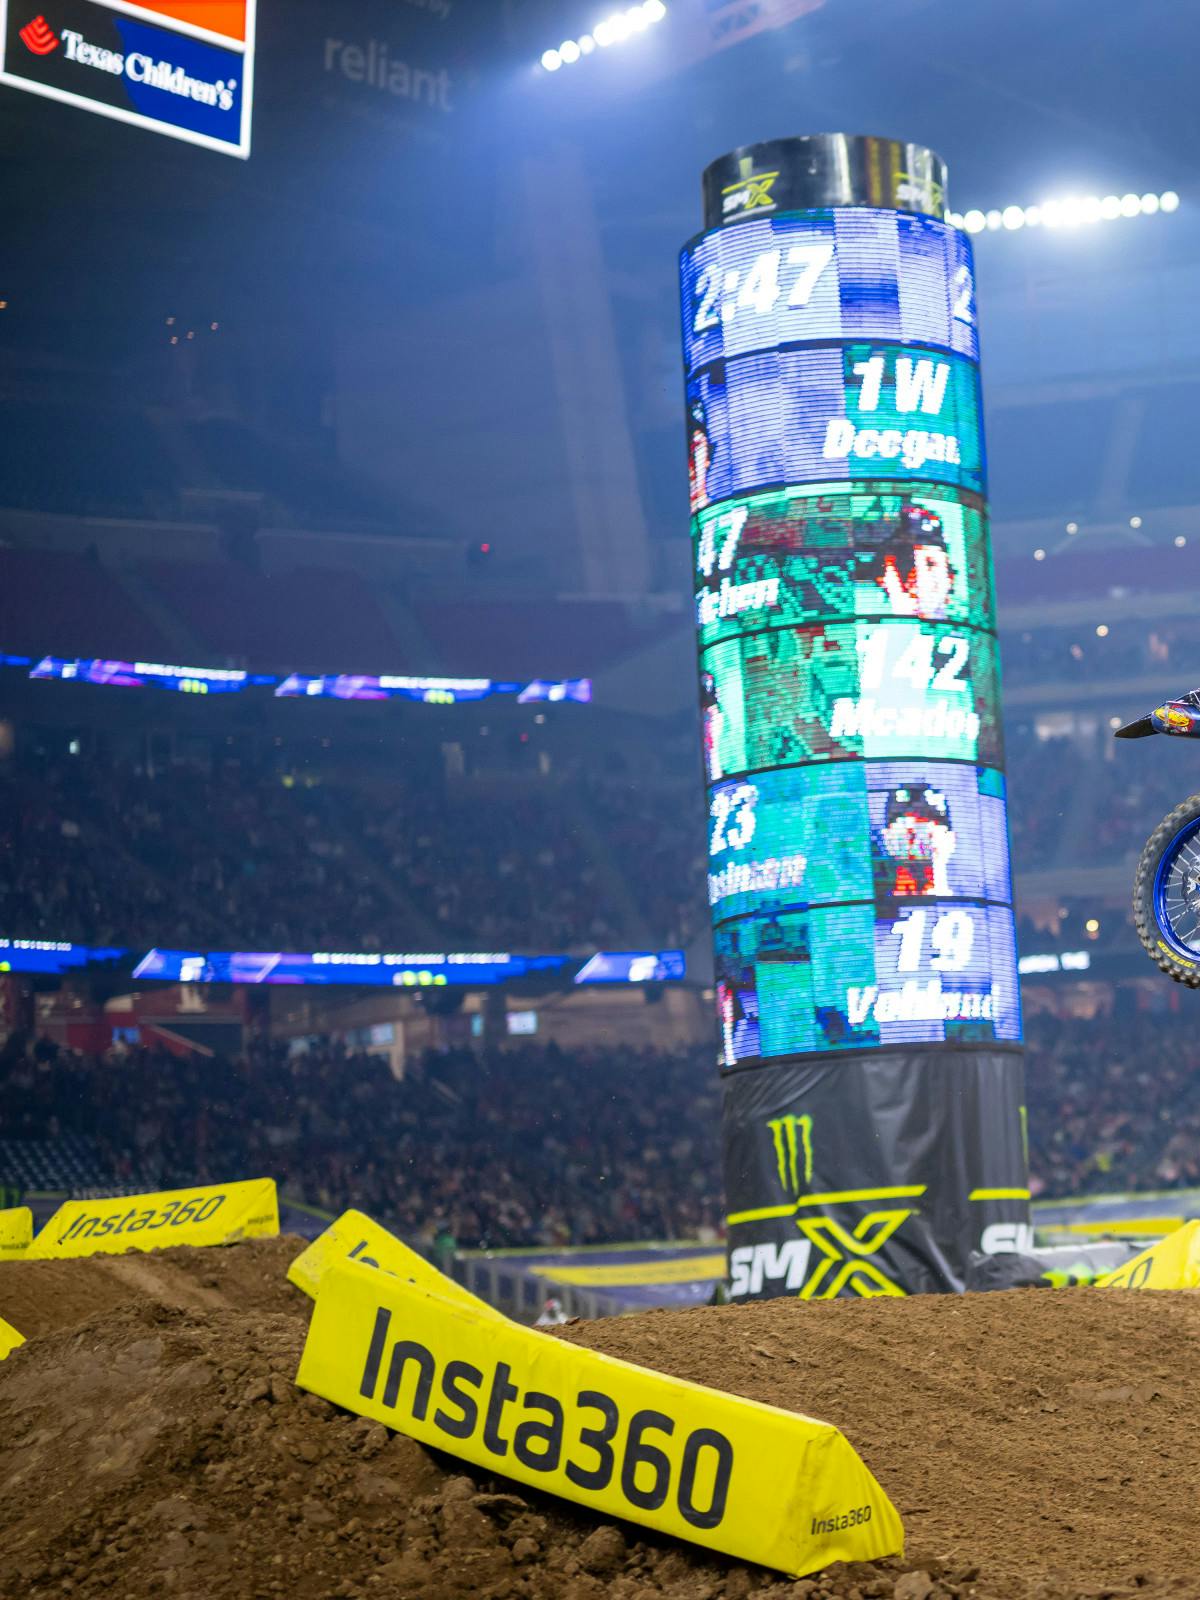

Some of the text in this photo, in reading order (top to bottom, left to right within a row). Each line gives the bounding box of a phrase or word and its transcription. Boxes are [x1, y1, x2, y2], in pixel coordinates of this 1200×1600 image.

[61, 29, 233, 111] Texas Children's
[325, 37, 453, 112] reliant
[694, 244, 835, 333] 2:47
[856, 629, 970, 692] 142
[710, 784, 758, 855] 23
[891, 910, 974, 972] 19
[60, 1195, 226, 1241] Insta360
[360, 1306, 733, 1529] Insta360
[810, 1505, 872, 1536] Insta360
